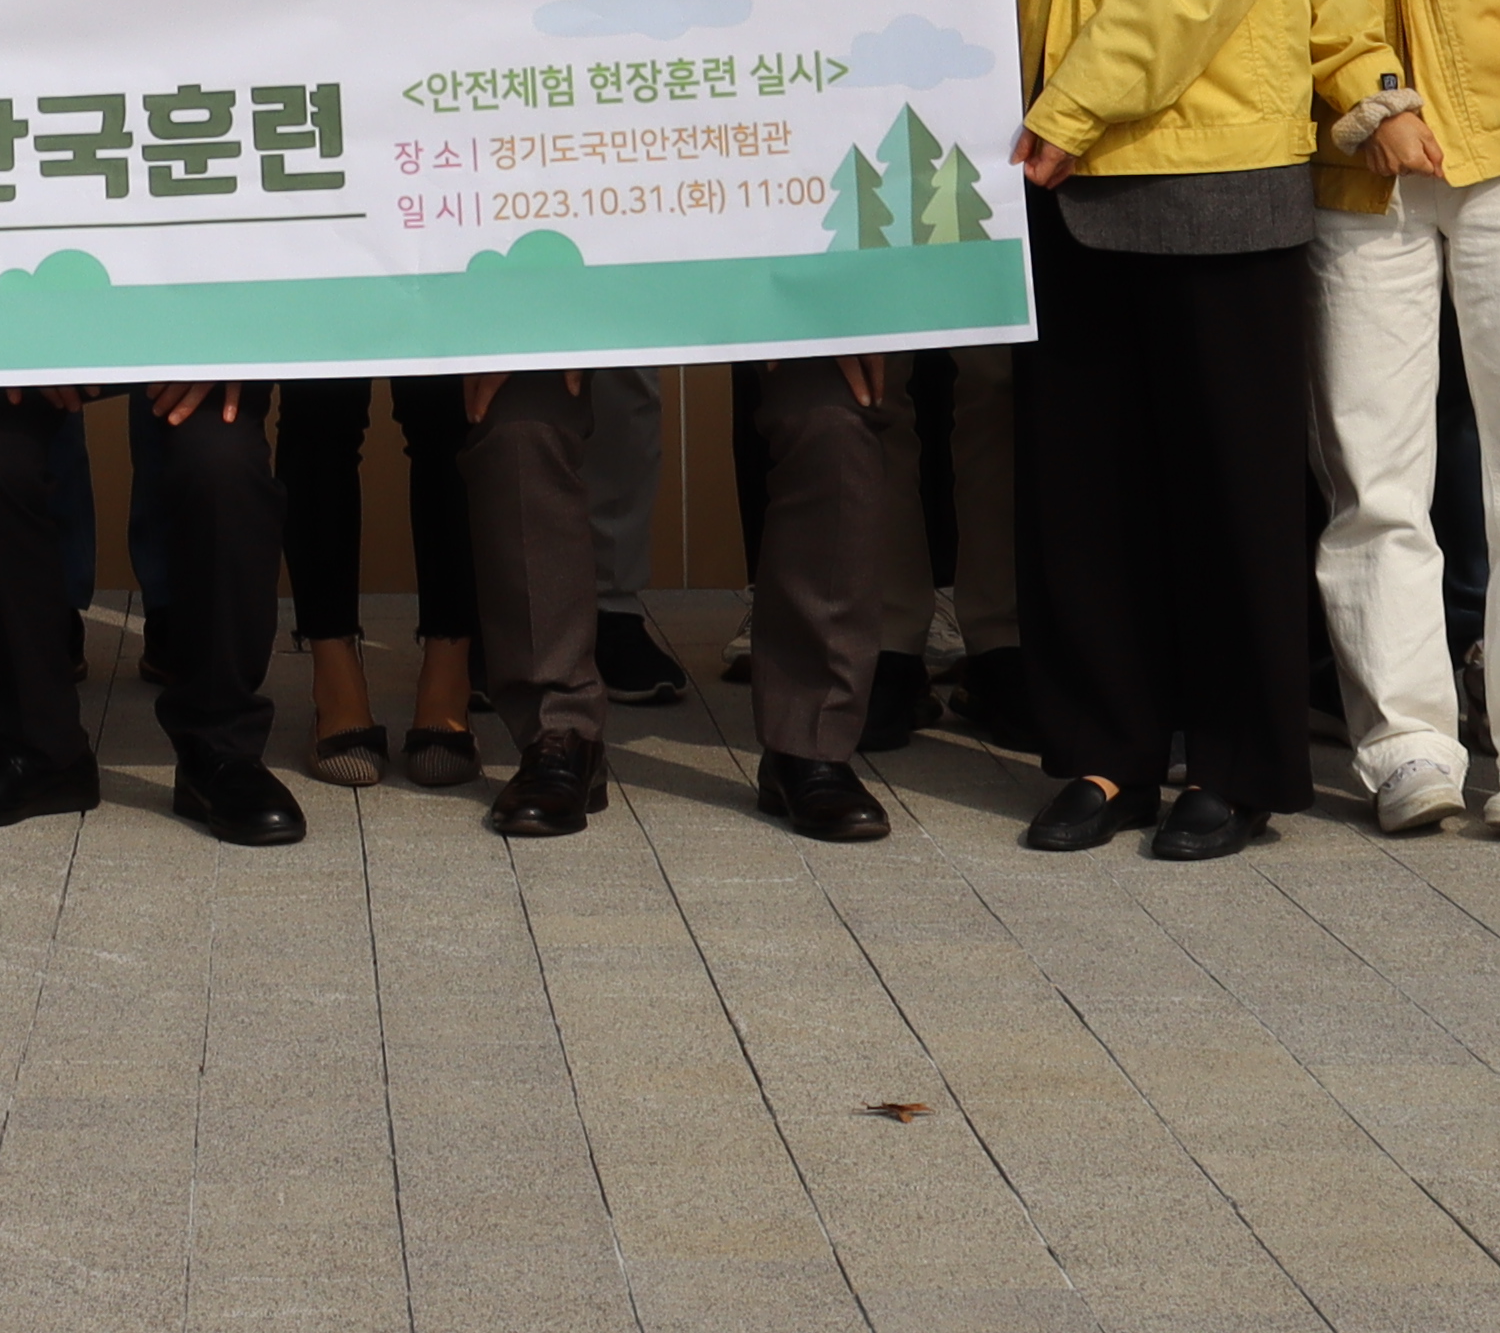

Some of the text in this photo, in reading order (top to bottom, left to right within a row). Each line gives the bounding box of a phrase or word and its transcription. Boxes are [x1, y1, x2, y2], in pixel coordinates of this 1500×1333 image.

[400, 50, 851, 115] <안전체험 현장훈련 실시>
[489, 120, 792, 171] 경기도국민안전체험관
[492, 179, 727, 222] 2023.10.31.(화)
[738, 175, 826, 209] 11:00
